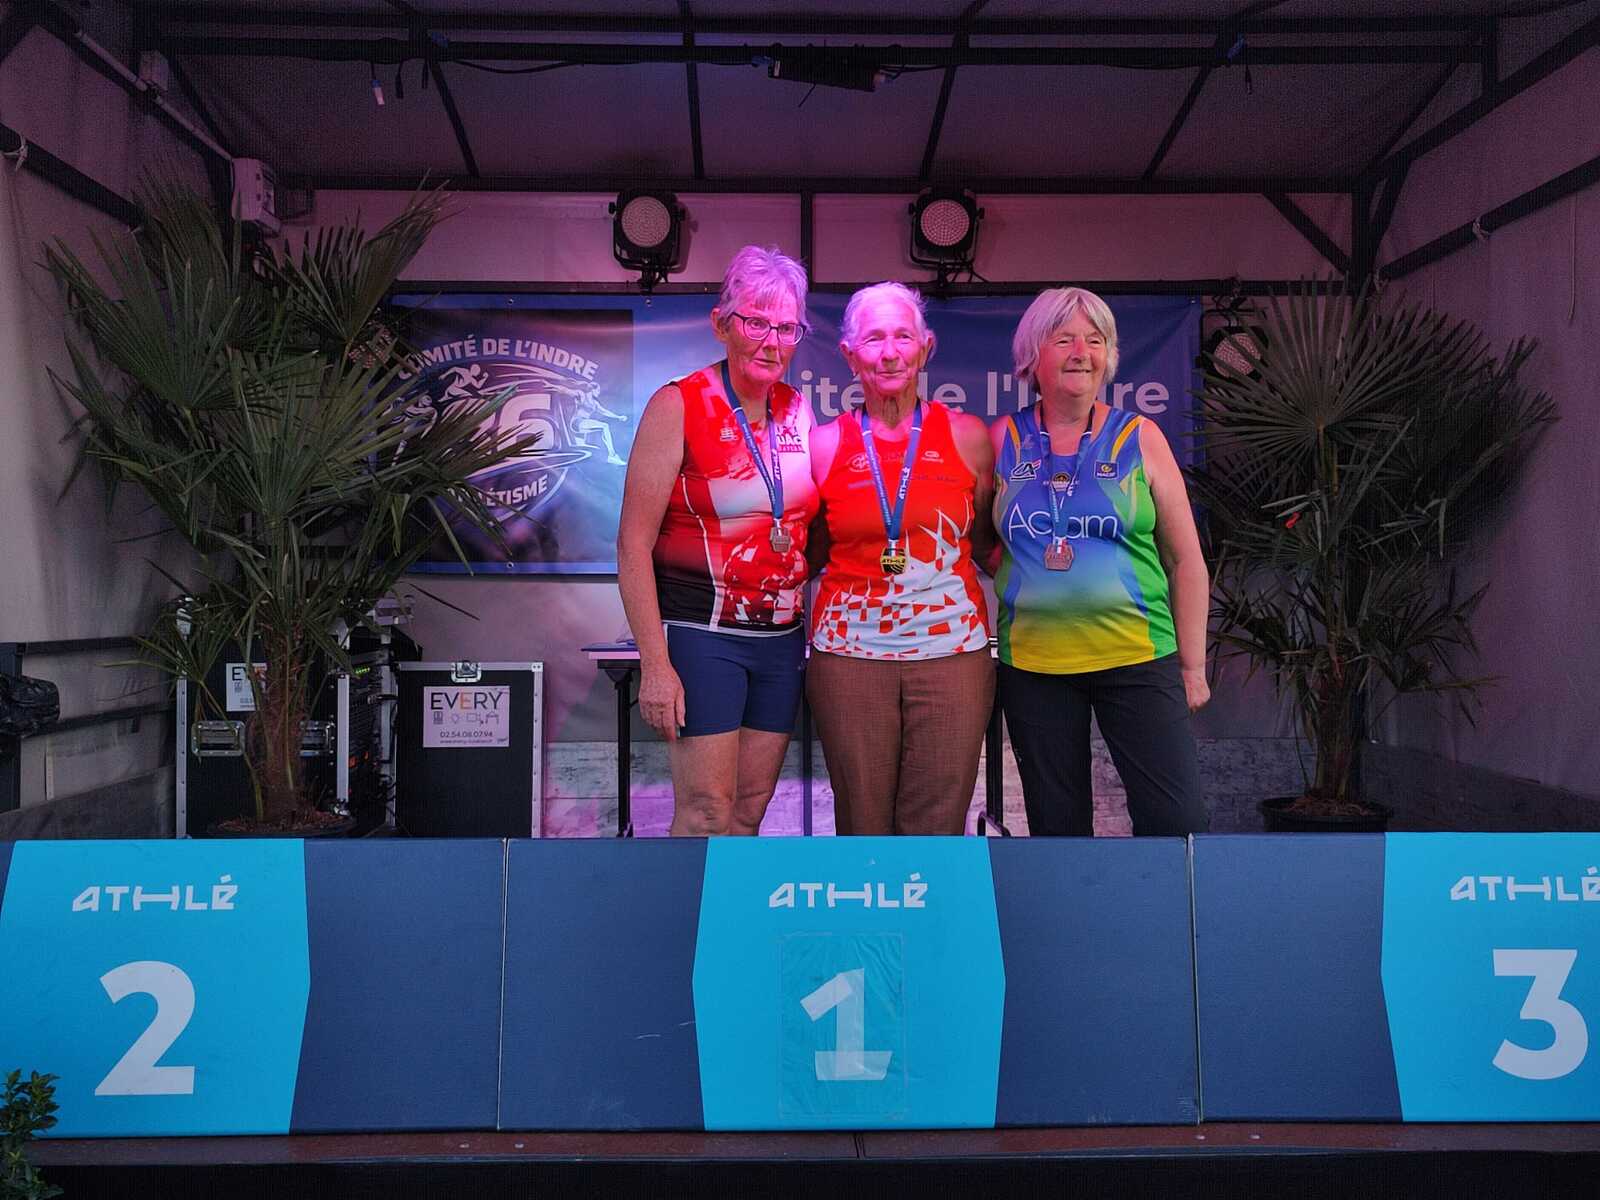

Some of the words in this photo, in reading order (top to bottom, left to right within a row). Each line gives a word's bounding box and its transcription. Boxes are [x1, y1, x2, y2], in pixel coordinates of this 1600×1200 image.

[483, 338, 510, 356] DE
[515, 340, 599, 381] L'INDRE
[800, 369, 866, 417] ité
[986, 371, 1170, 416] l'Ire
[430, 691, 503, 710] EVERY
[72, 874, 238, 912] ATHLÉ
[769, 872, 928, 908] ATHLÉ
[1450, 866, 1600, 901] ATHLÉ
[94, 960, 195, 1096] 2
[800, 967, 893, 1080] 1
[1492, 948, 1589, 1080] 3
